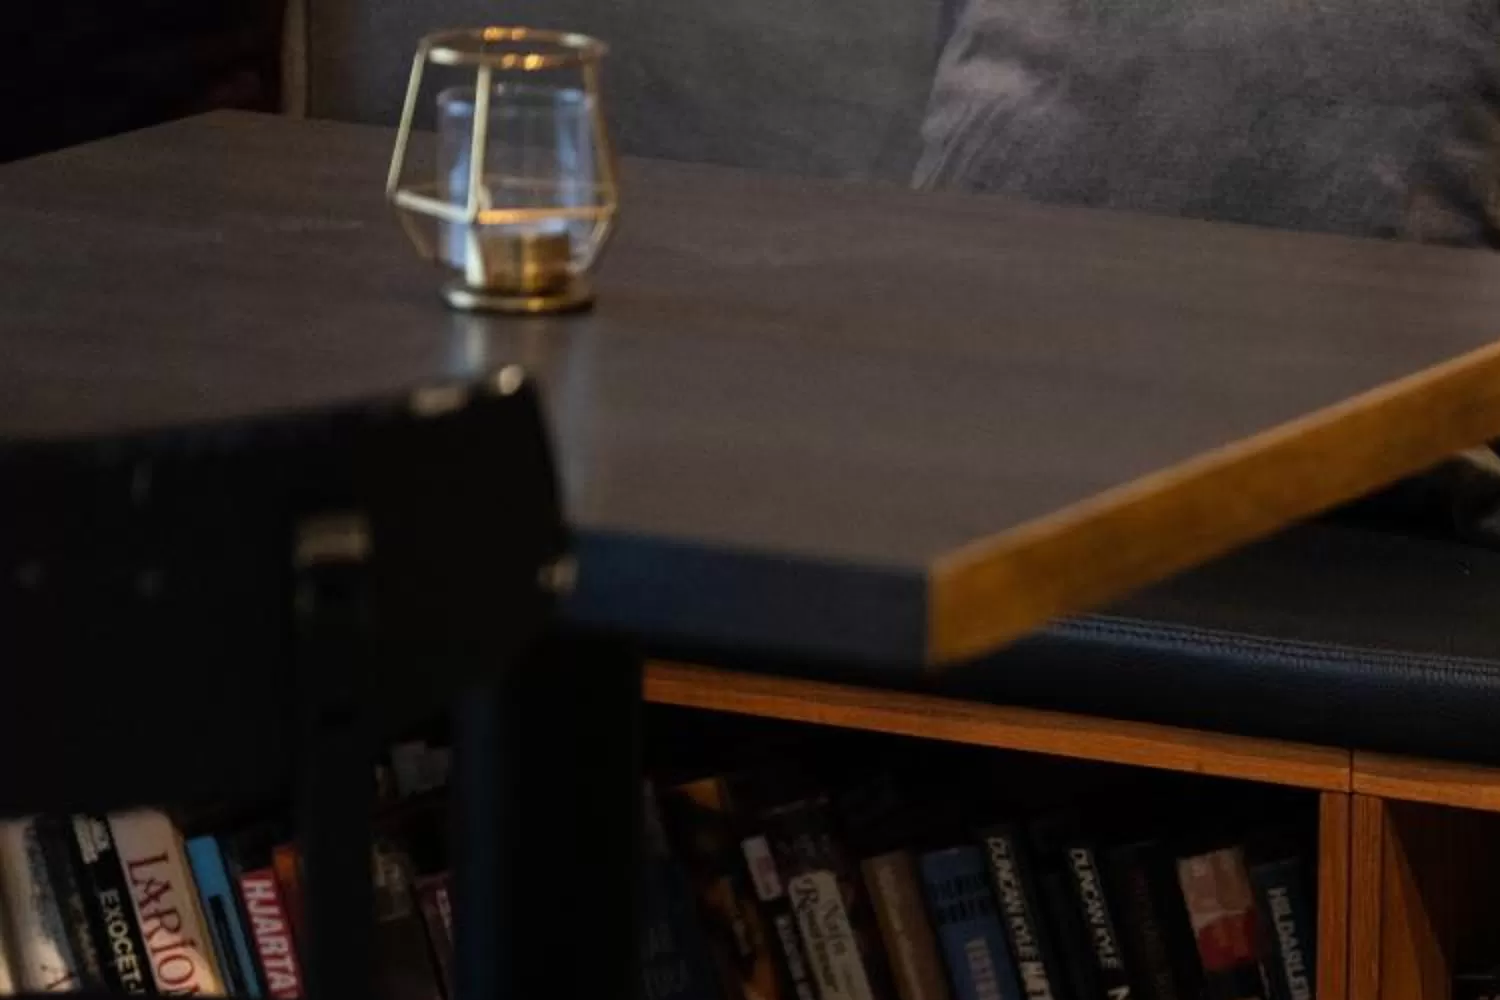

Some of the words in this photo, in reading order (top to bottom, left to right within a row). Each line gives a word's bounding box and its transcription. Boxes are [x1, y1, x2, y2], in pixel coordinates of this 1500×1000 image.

[987, 836, 1026, 915] DUNCAN
[1071, 848, 1107, 924] DUNCAN
[1095, 927, 1121, 969] KYLE
